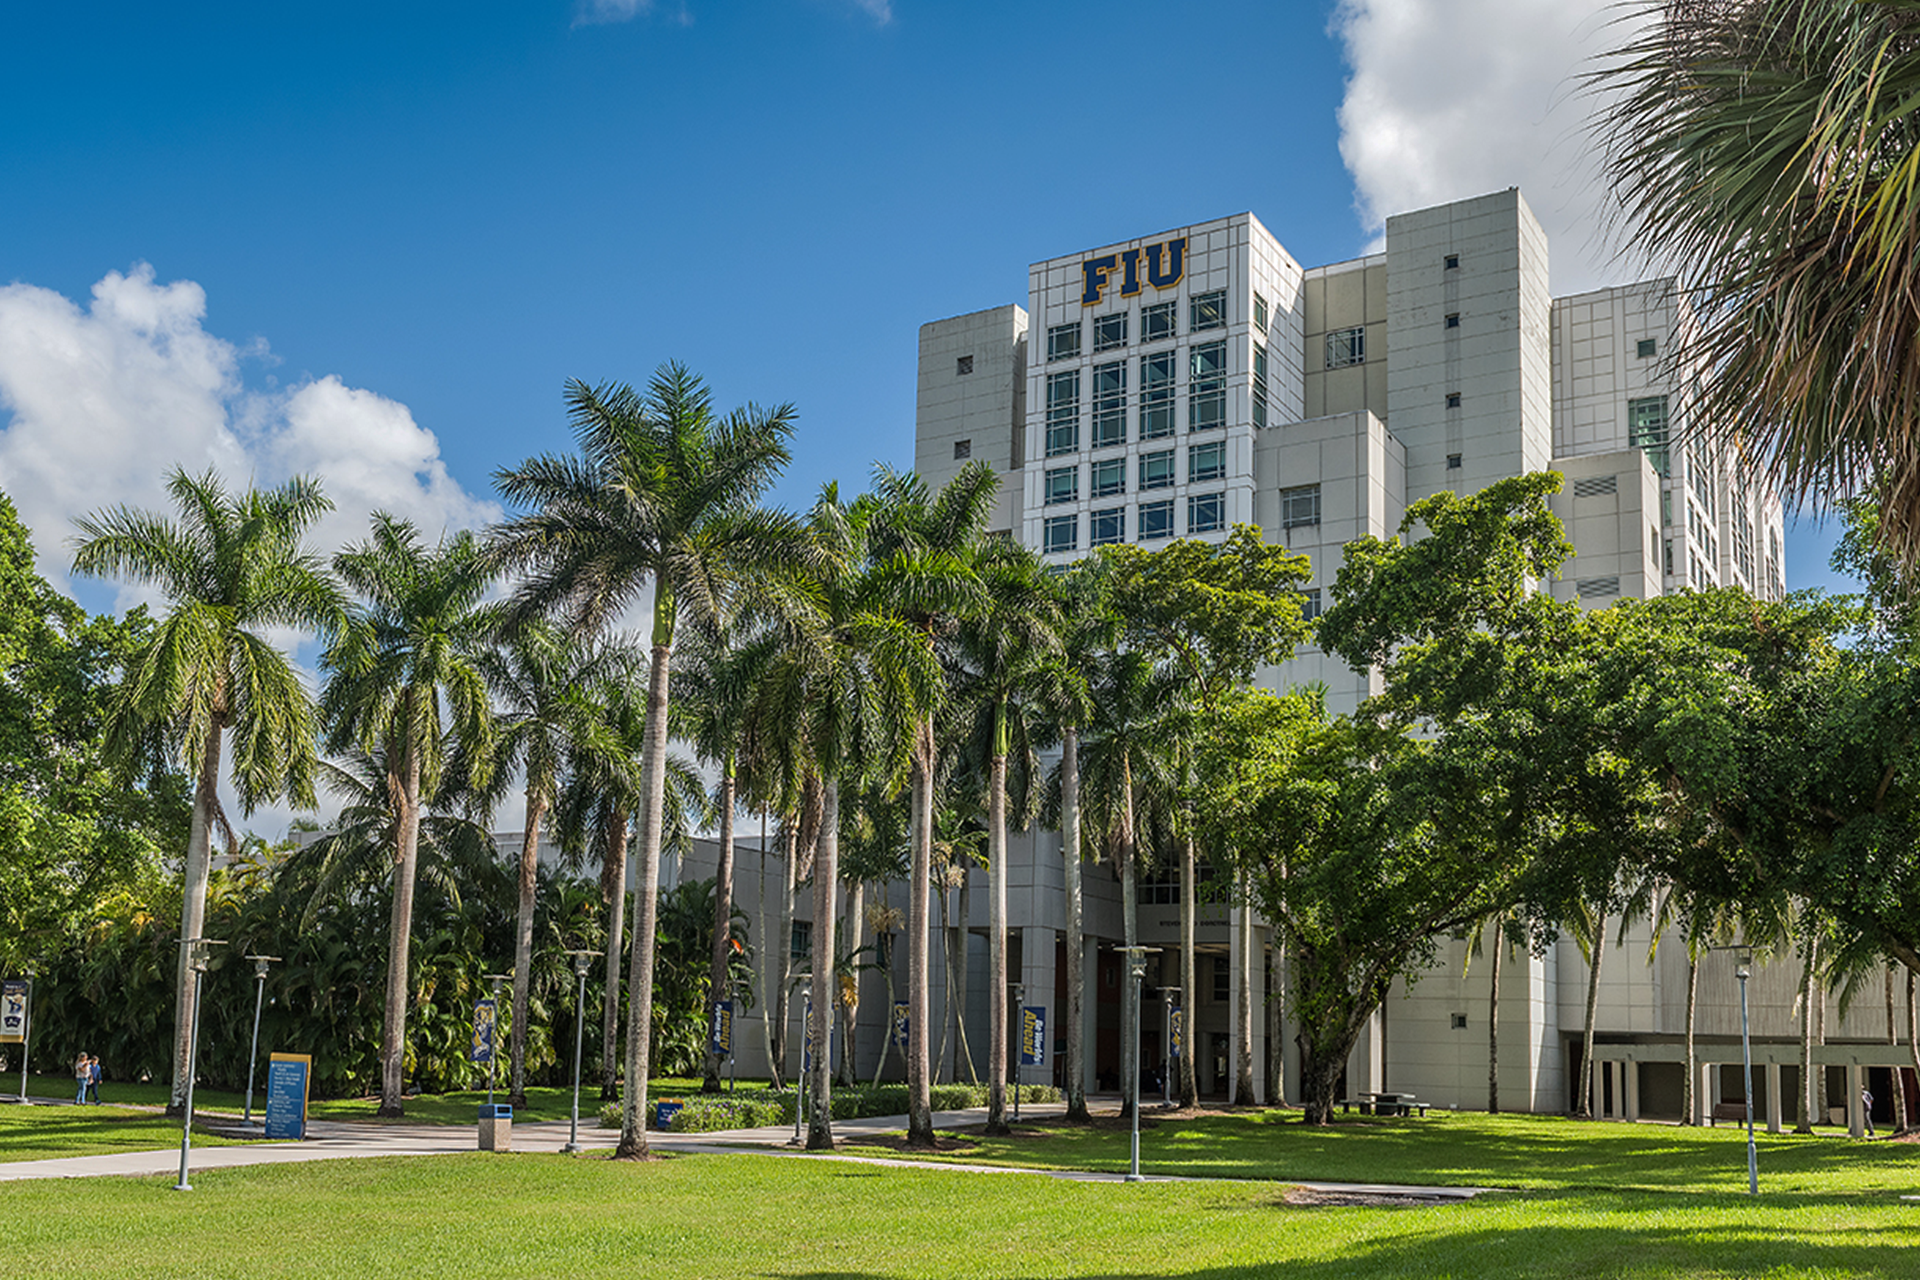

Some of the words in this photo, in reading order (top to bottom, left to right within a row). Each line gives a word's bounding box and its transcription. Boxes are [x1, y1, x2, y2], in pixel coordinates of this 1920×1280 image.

[1081, 236, 1188, 307] FIU
[719, 1009, 731, 1051] Ahead
[1023, 1009, 1037, 1056] Ahead
[1035, 1019, 1044, 1031] Be
[1033, 1032, 1043, 1062] Worlds
